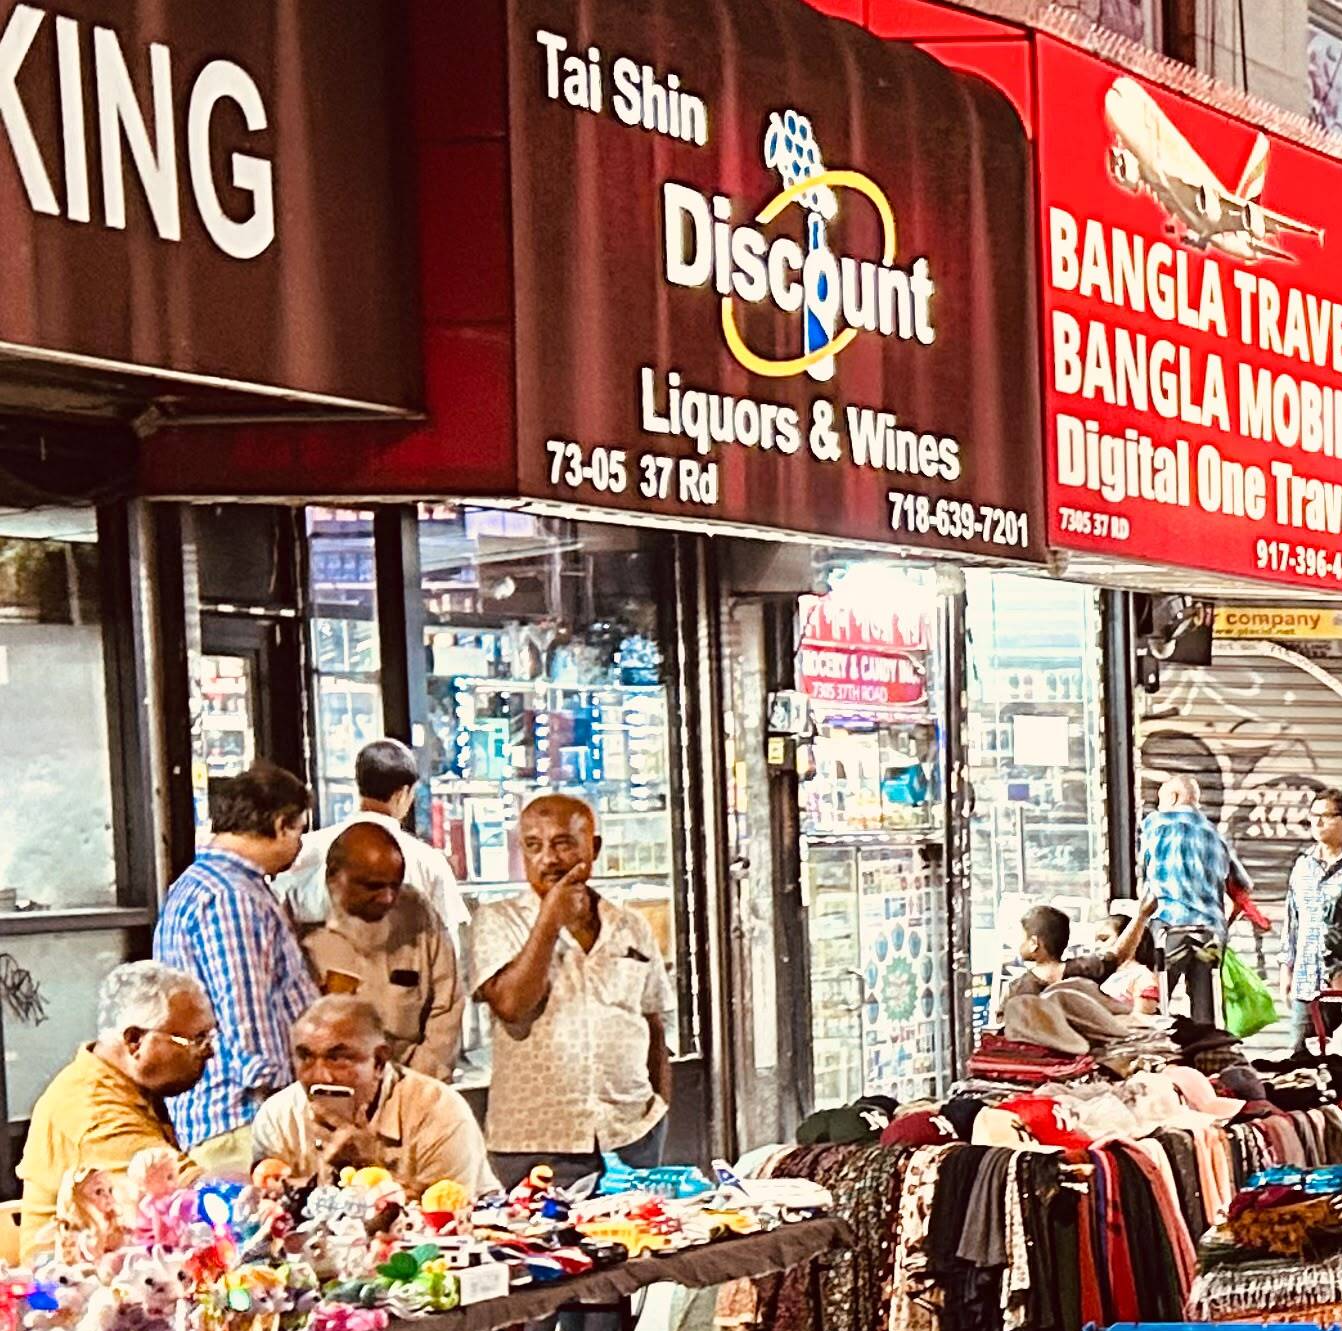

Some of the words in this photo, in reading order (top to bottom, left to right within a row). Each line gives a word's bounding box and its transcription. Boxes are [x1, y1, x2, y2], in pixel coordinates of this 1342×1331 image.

[536, 30, 602, 114] Tai
[612, 56, 708, 147] Shin
[663, 182, 936, 346] Discount
[1048, 206, 1228, 338] BANGLA
[641, 367, 801, 456] Liquors
[809, 399, 842, 463] &
[847, 406, 961, 482] Wines
[1051, 309, 1231, 433] BANGLA
[547, 440, 628, 494] 73-05
[640, 455, 674, 499] 37
[679, 461, 719, 506] Rd
[889, 491, 1029, 548] 718-639-7201
[1055, 412, 1190, 508] Digital
[1197, 446, 1266, 521] One
[1058, 506, 1092, 535] 7305
[1093, 512, 1109, 537] 37
[802, 650, 847, 678] ROCERY
[1226, 613, 1321, 630] company
